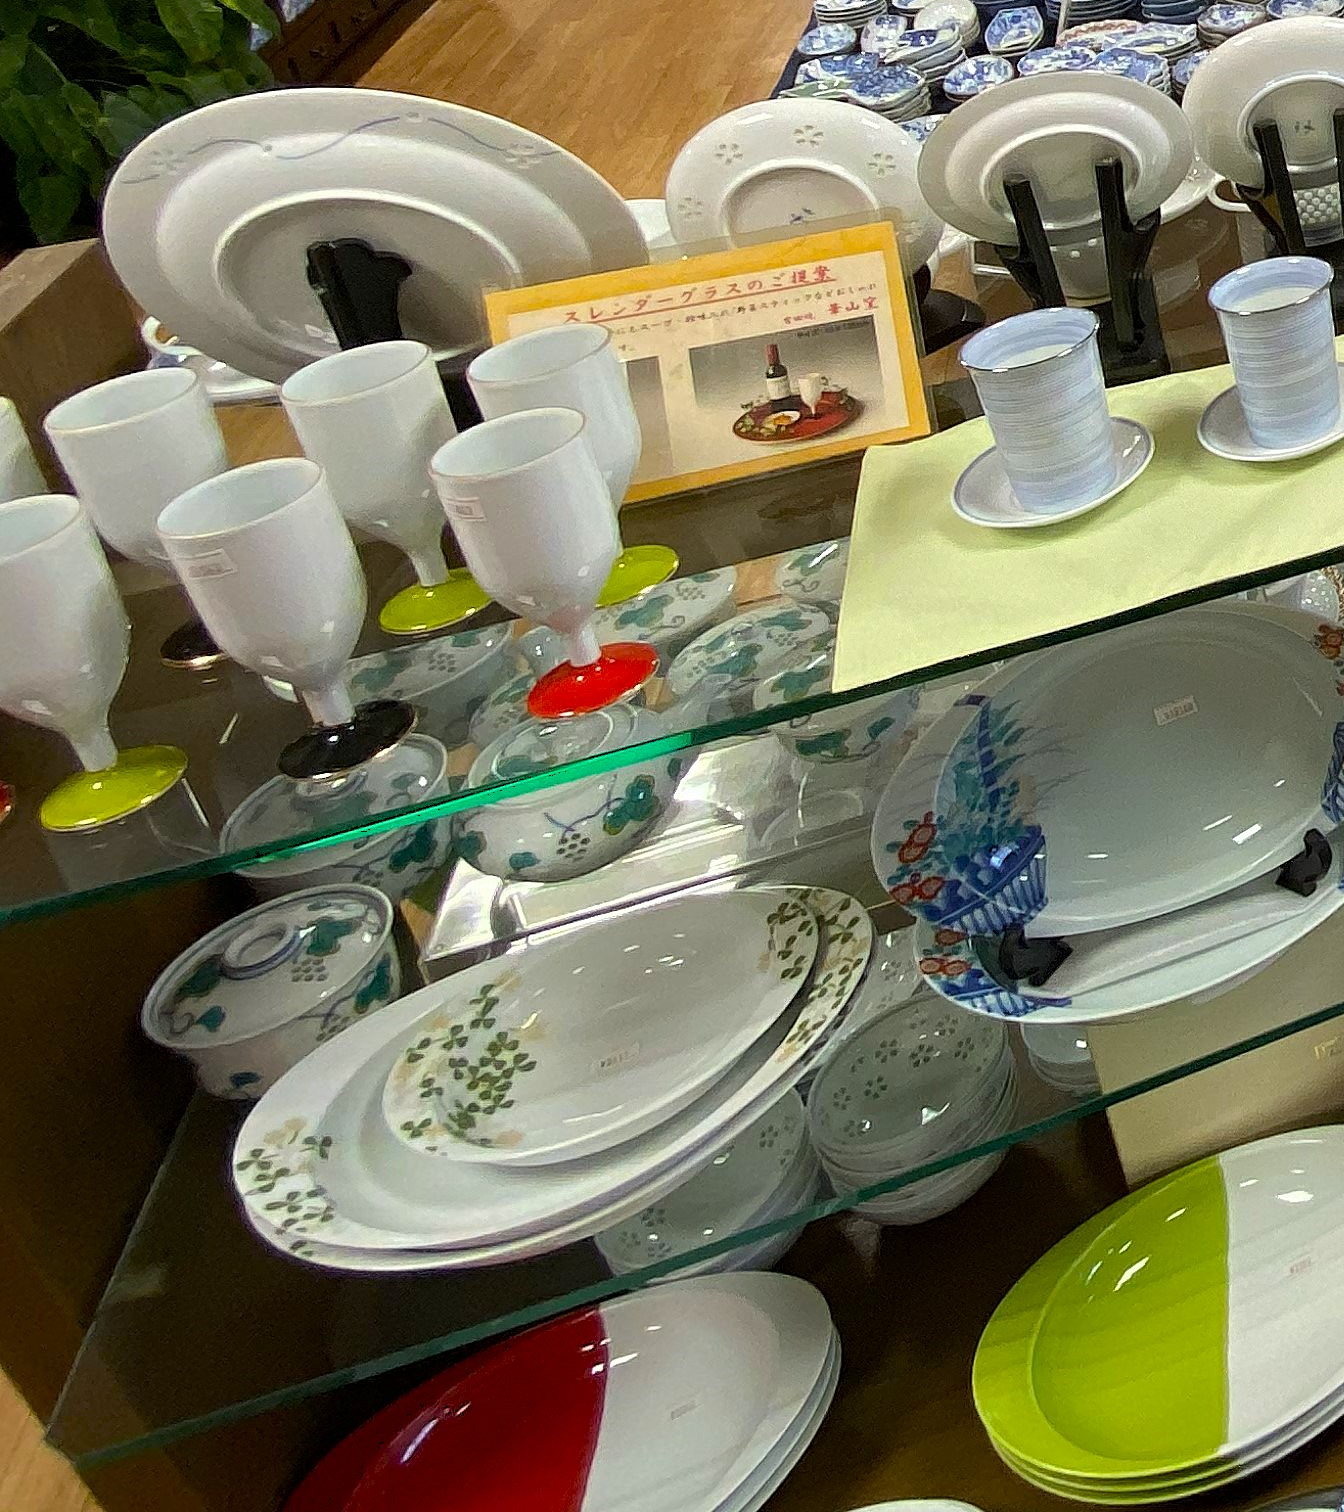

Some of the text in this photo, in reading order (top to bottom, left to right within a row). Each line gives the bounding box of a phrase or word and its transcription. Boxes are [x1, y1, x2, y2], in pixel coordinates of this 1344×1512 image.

[563, 264, 834, 323] スレンダーグラスのご提案
